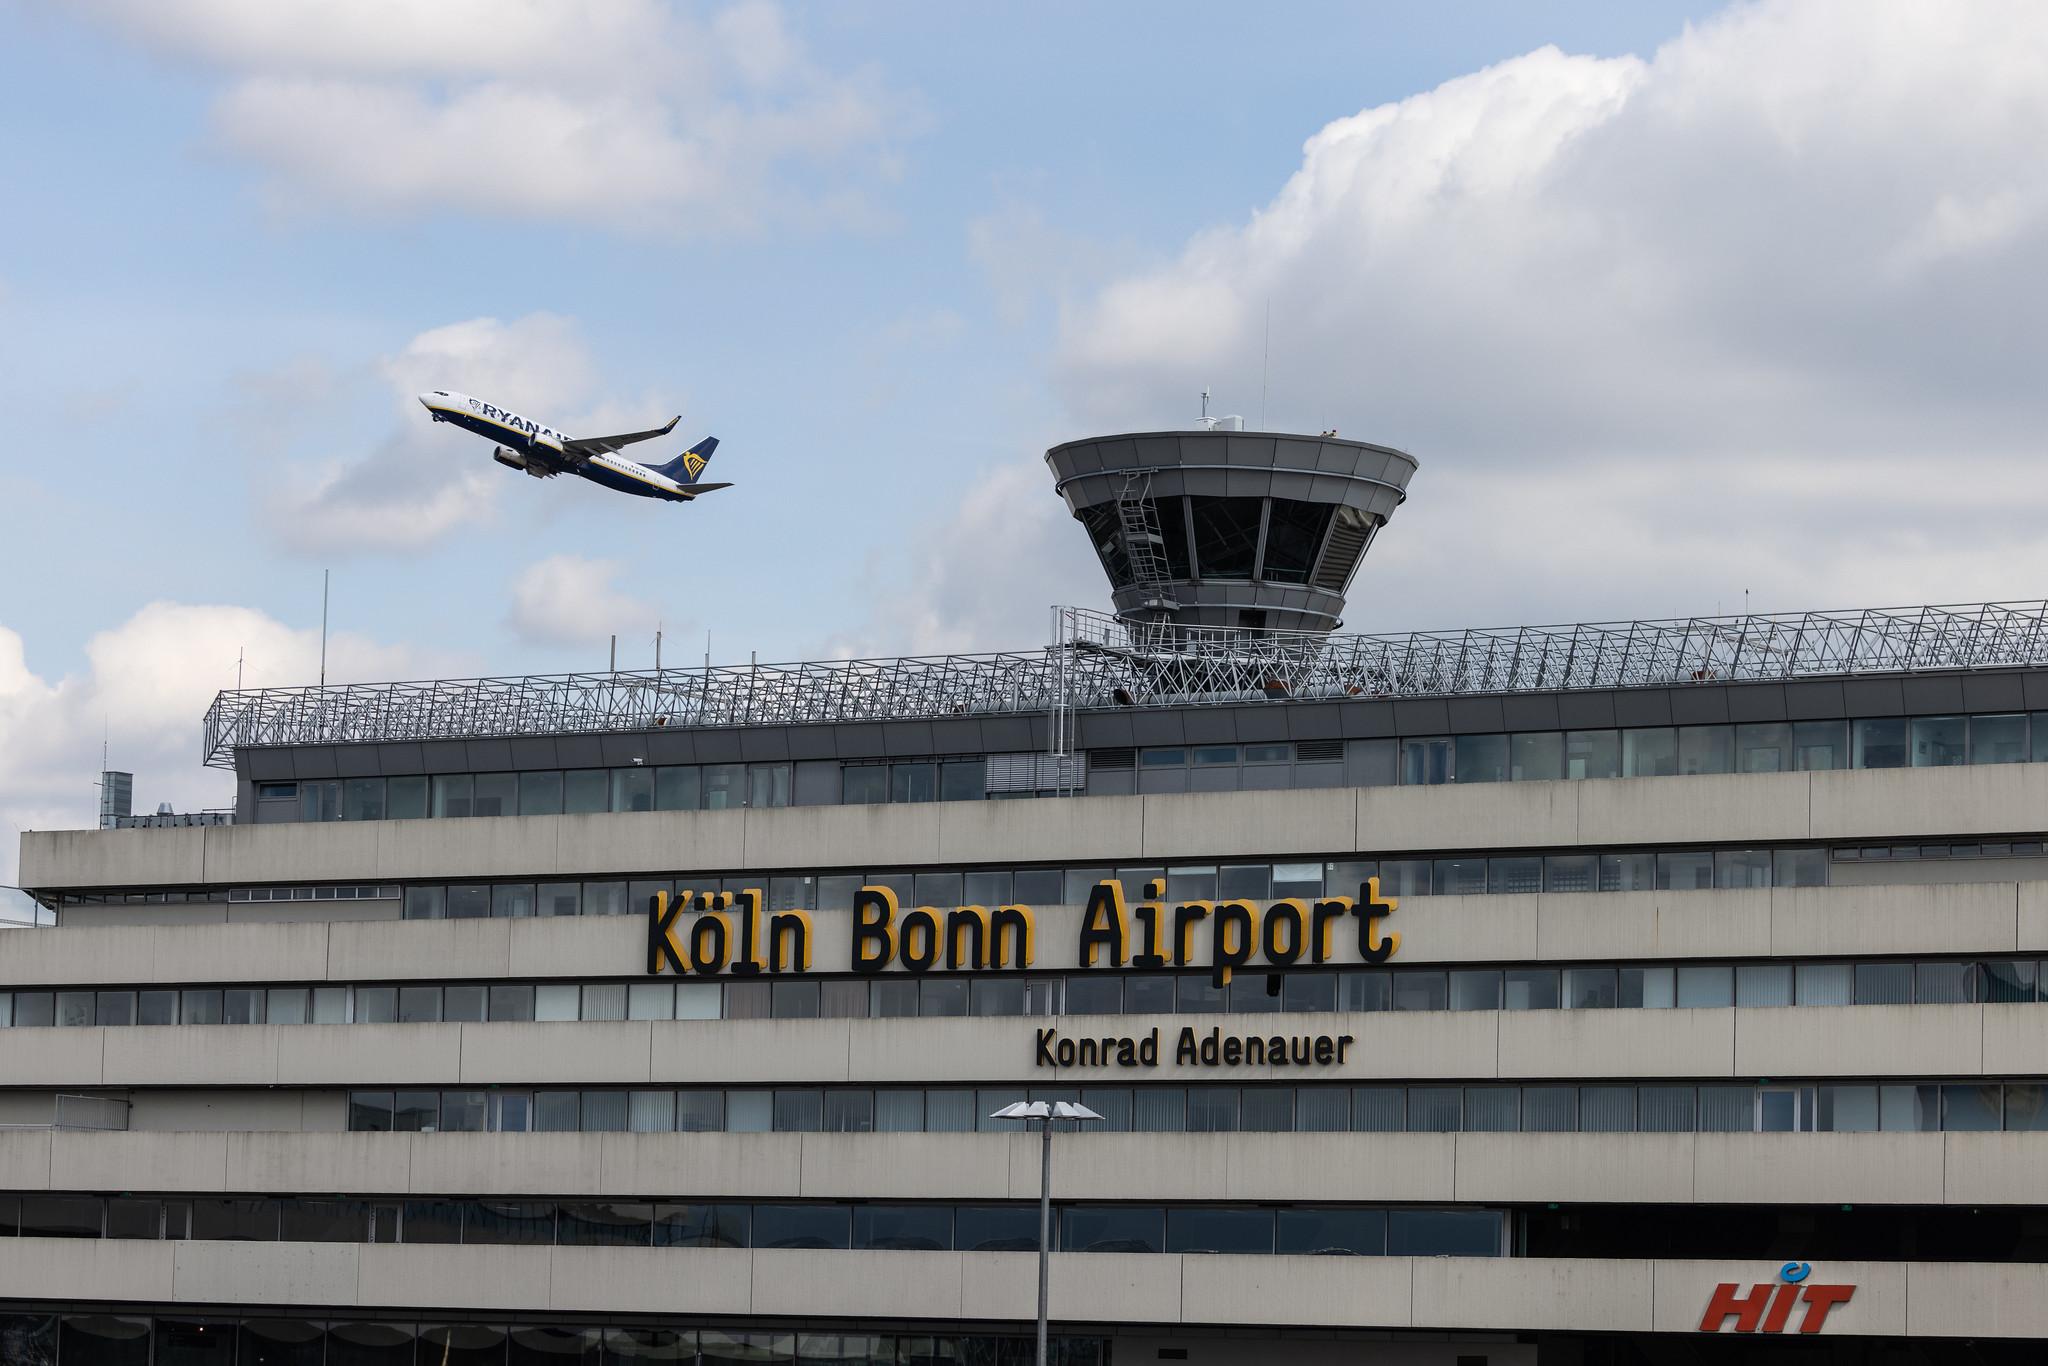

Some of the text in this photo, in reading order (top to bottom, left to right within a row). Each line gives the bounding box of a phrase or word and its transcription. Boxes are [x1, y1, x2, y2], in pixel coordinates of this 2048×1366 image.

[646, 876, 1401, 989] Köln Bonn Airport
[1036, 1026, 1354, 1067] Konrad Adenauer
